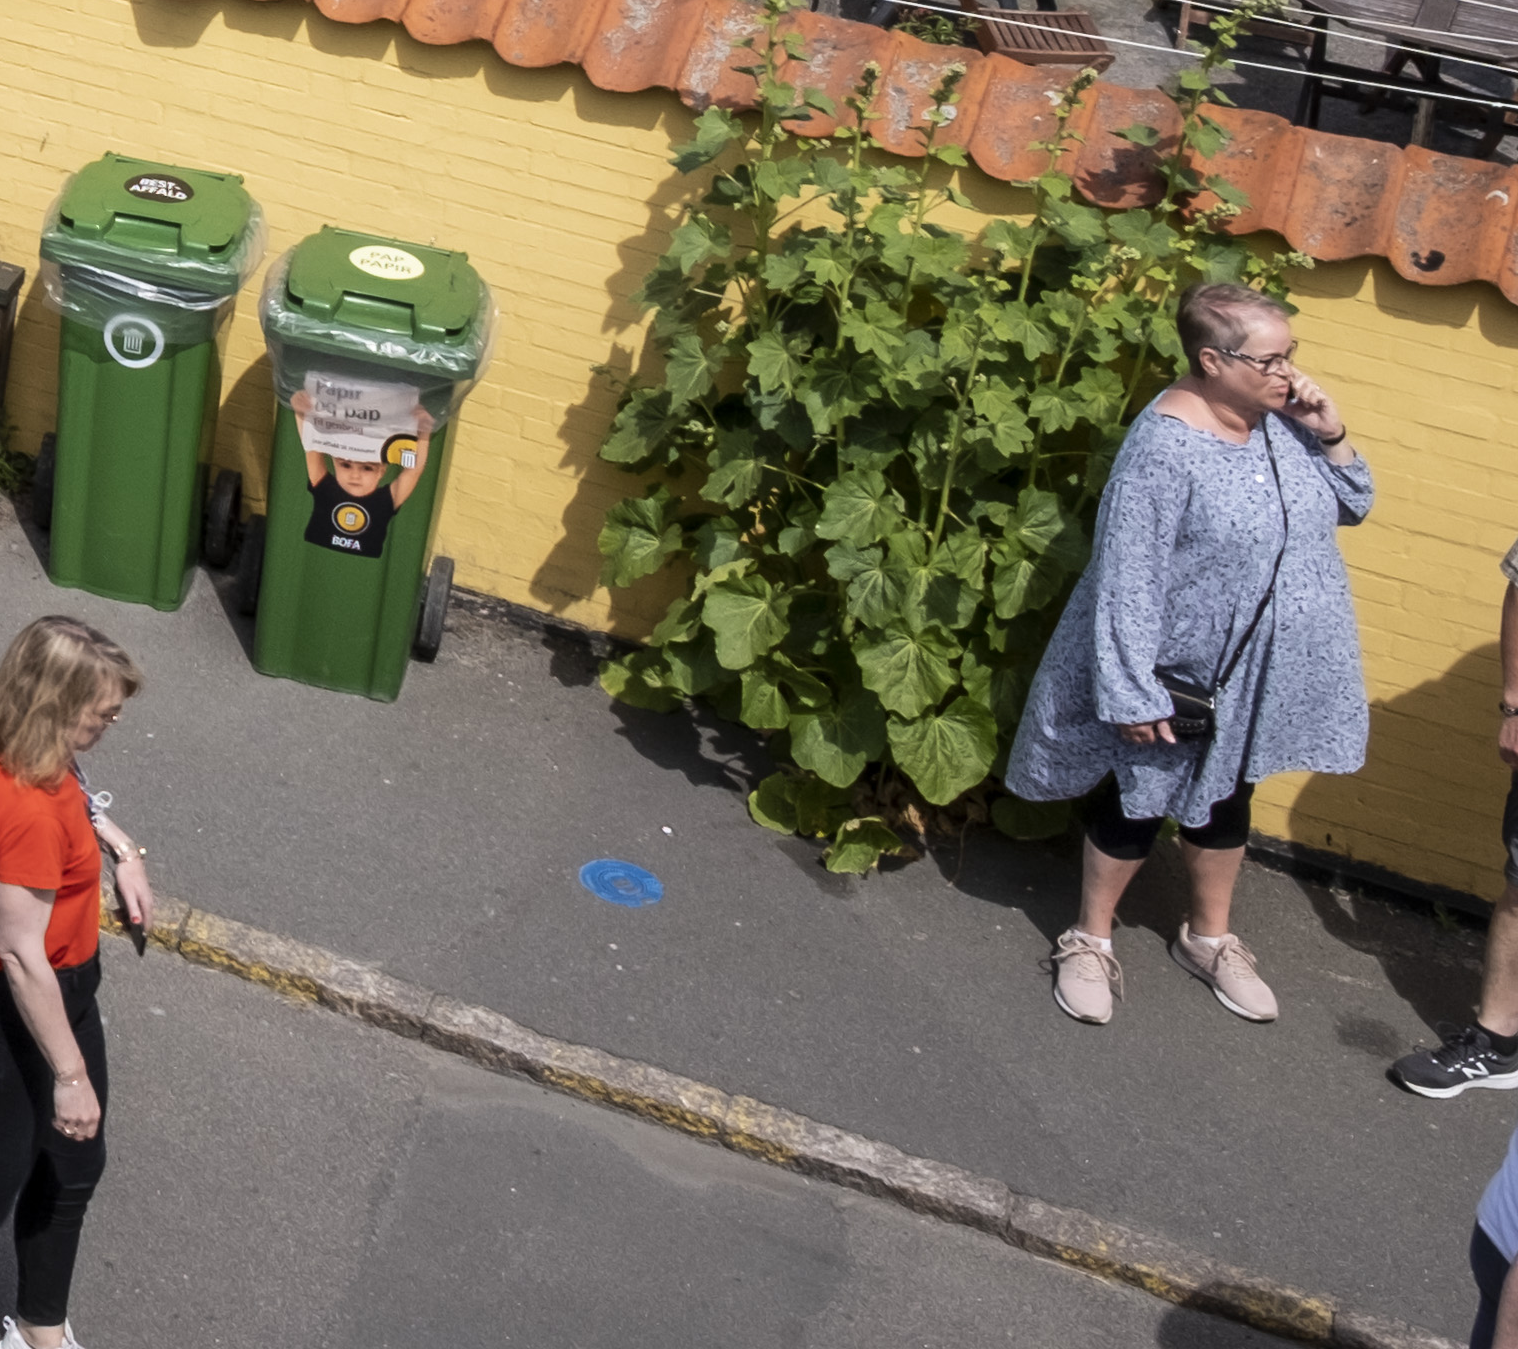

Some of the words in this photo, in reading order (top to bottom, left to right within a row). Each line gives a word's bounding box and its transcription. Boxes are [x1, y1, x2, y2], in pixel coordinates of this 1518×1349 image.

[129, 184, 188, 201] AFFALD
[139, 177, 183, 191] BEST-
[370, 251, 405, 263] PAP
[359, 258, 412, 275] PAPIR
[343, 406, 381, 425] pap
[331, 534, 362, 552] BOFA
